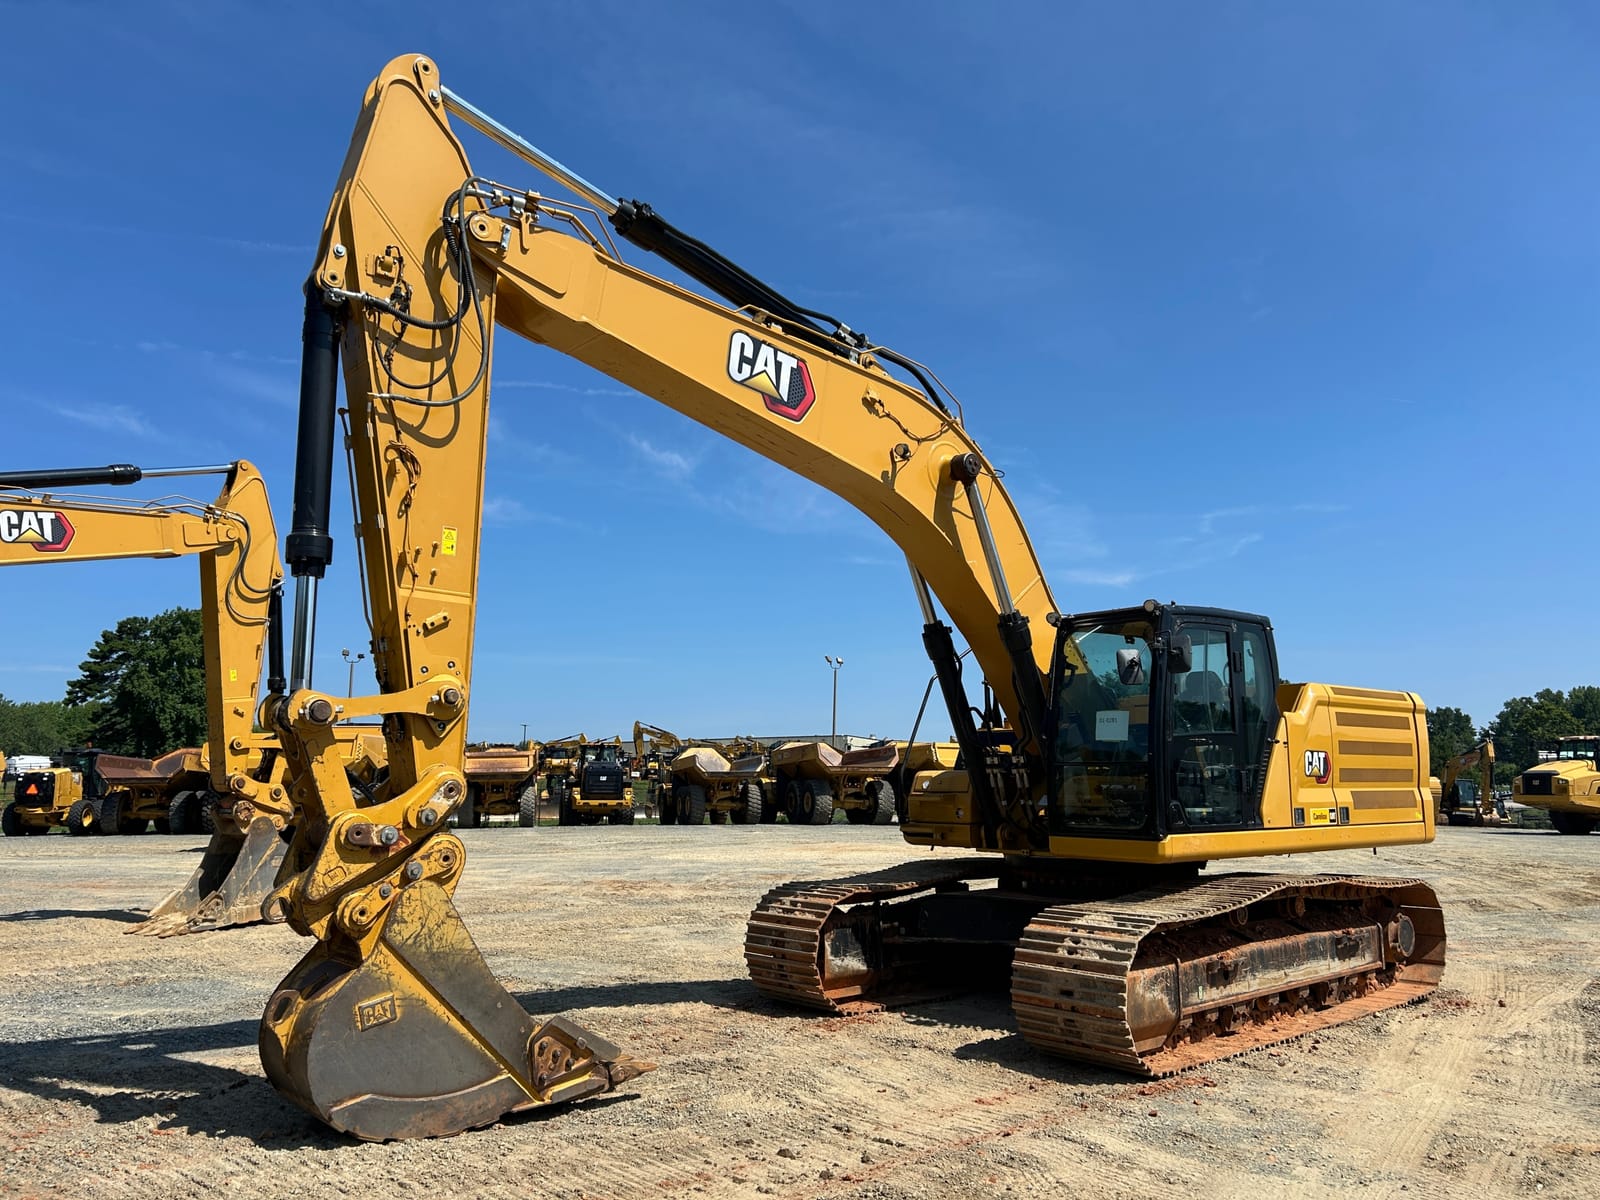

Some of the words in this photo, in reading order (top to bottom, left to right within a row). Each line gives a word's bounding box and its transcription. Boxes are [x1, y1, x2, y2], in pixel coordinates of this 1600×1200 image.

[728, 332, 798, 402] CAT
[0, 510, 56, 542] CAT
[1304, 750, 1326, 776] CAT
[363, 1000, 392, 1026] CAT
